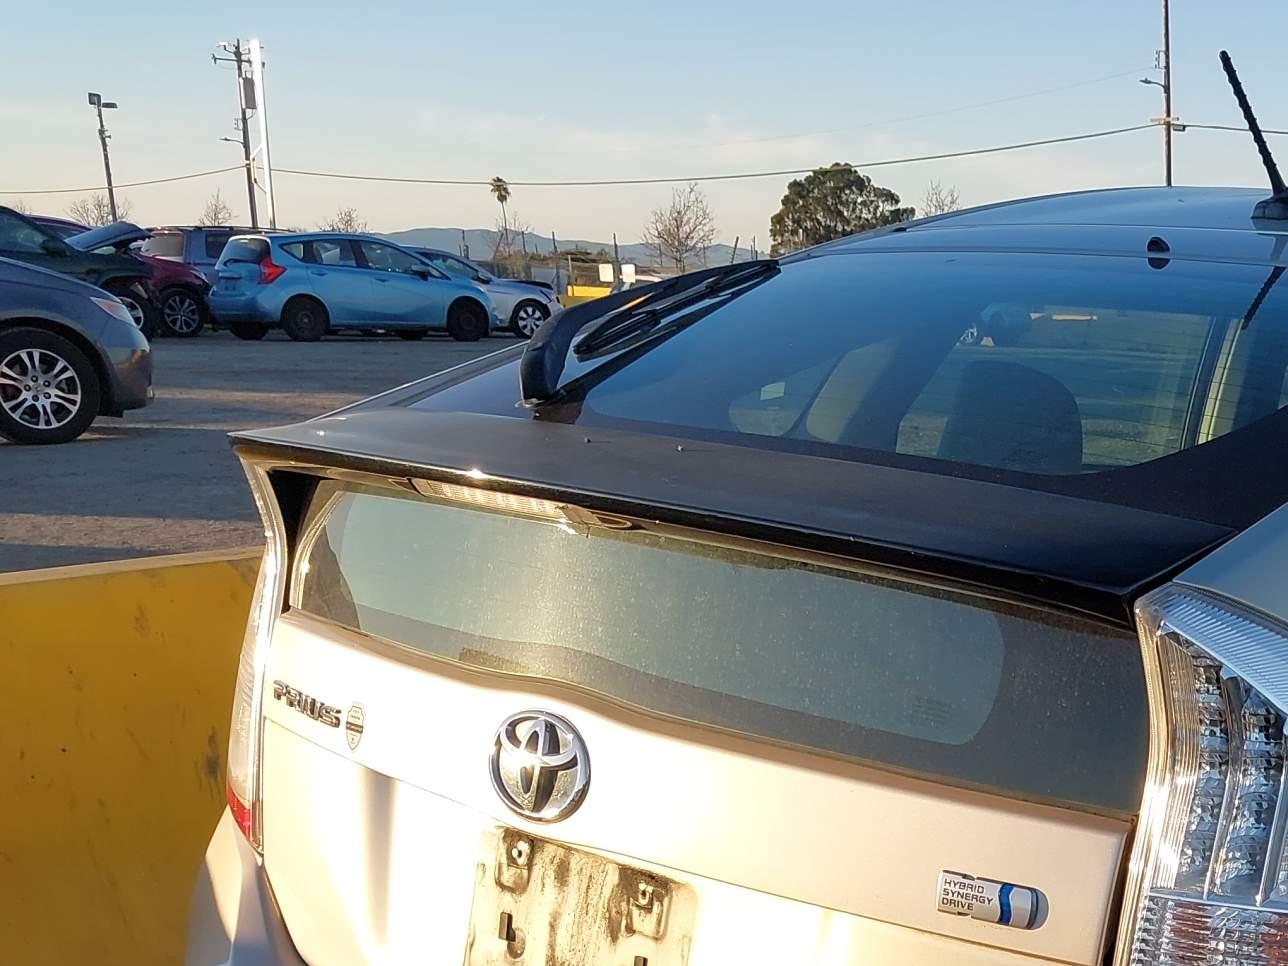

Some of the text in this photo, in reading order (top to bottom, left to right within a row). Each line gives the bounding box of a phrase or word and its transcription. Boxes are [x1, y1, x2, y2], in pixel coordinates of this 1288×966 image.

[273, 680, 342, 728] PRIUS
[944, 878, 985, 894] HYBRID
[941, 897, 974, 911] DRIVE
[942, 888, 994, 905] SYNERGY
